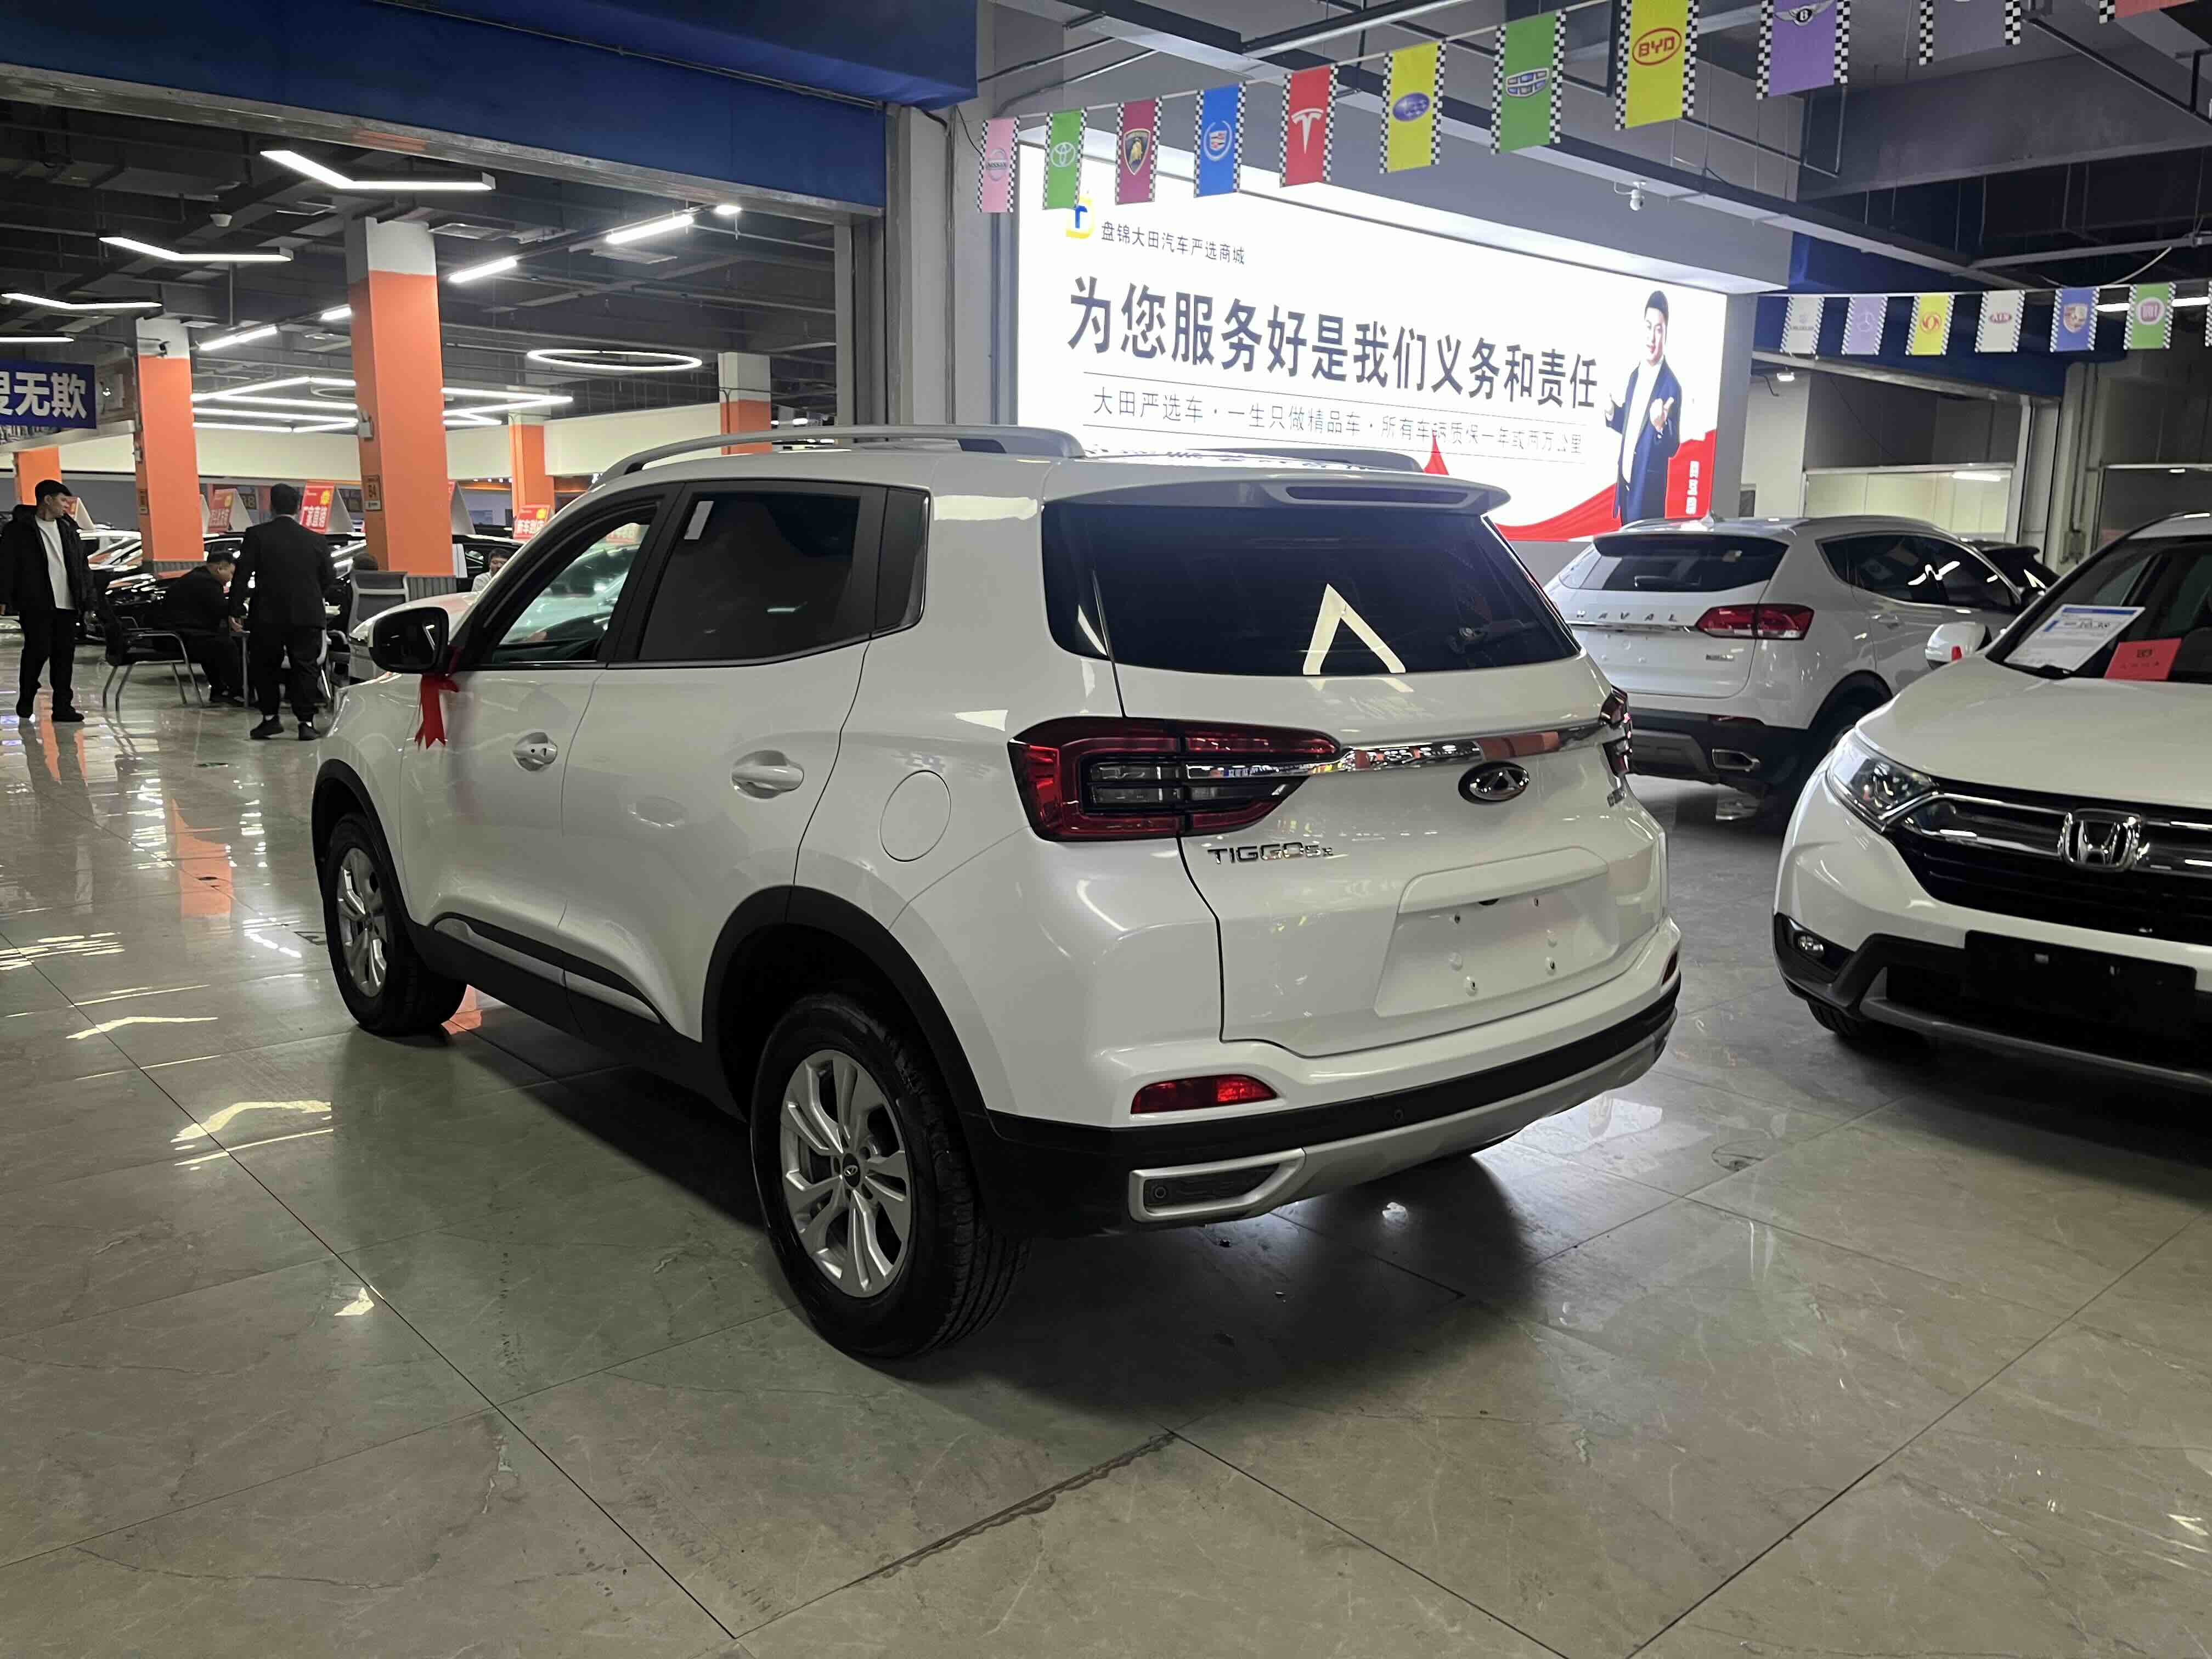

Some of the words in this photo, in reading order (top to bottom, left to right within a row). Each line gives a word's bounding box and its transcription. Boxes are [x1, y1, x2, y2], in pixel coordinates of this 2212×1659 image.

[1639, 36, 1675, 57] BYD
[1102, 221, 1245, 264] 盘锦大田汽车严选商城
[1068, 276, 1598, 409] 为您服务好是我们义务和责任
[1576, 610, 1678, 622] HAVAL
